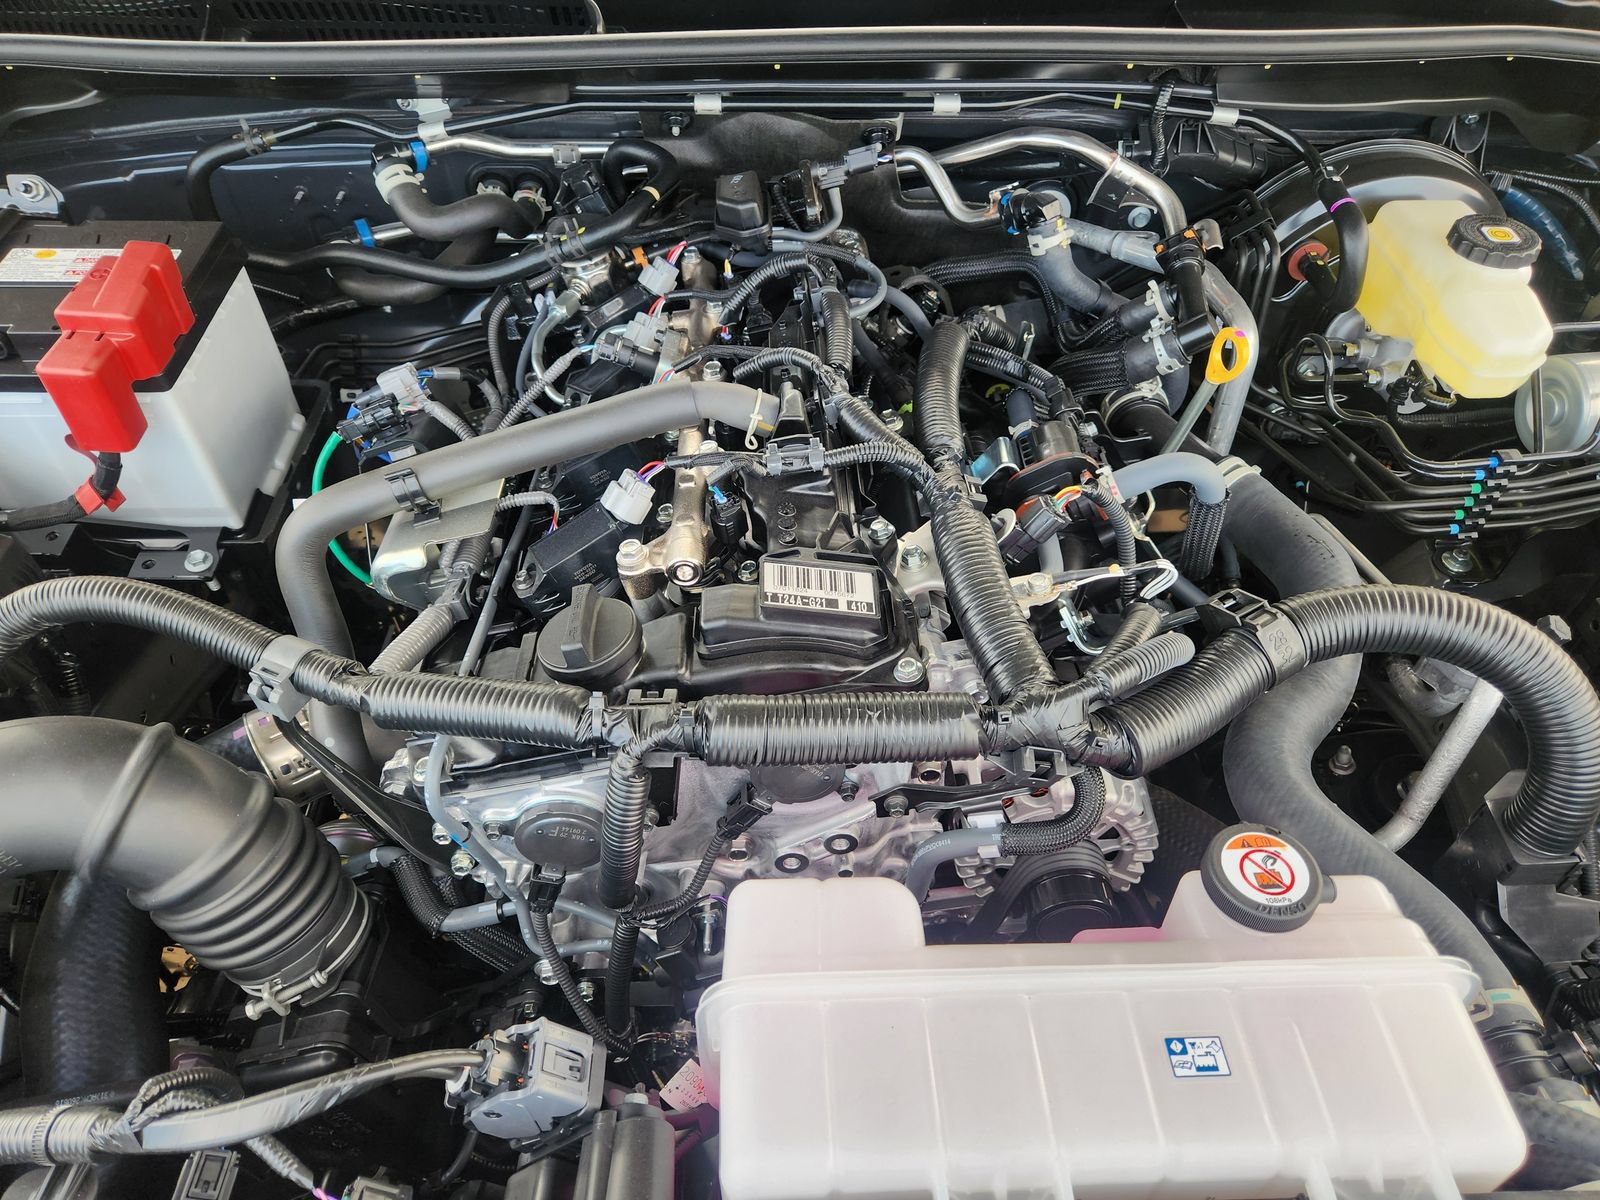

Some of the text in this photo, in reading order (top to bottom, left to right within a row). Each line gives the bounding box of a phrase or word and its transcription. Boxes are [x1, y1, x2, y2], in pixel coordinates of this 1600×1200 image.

[766, 592, 867, 612] T T24A-G21 410
[1269, 629, 1288, 651] 28
[549, 826, 560, 837] F
[1265, 896, 1293, 904] 108kPa
[1256, 901, 1307, 917] DENSO
